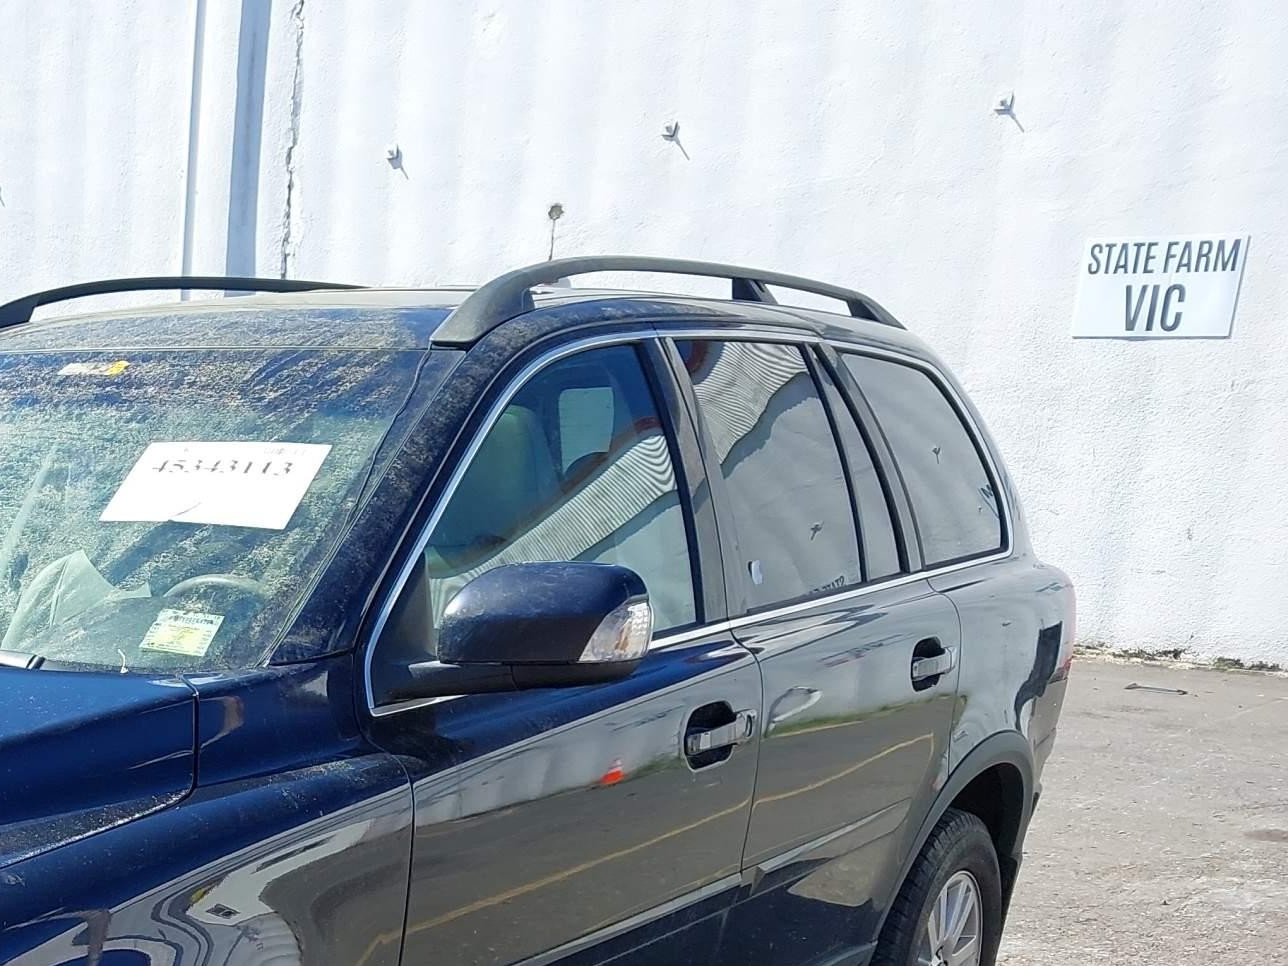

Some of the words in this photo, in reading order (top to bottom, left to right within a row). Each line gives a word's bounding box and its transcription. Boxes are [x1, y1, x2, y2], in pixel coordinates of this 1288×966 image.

[1088, 242, 1159, 275] STATE
[1162, 238, 1242, 274] FARM
[1124, 283, 1186, 332] VIC
